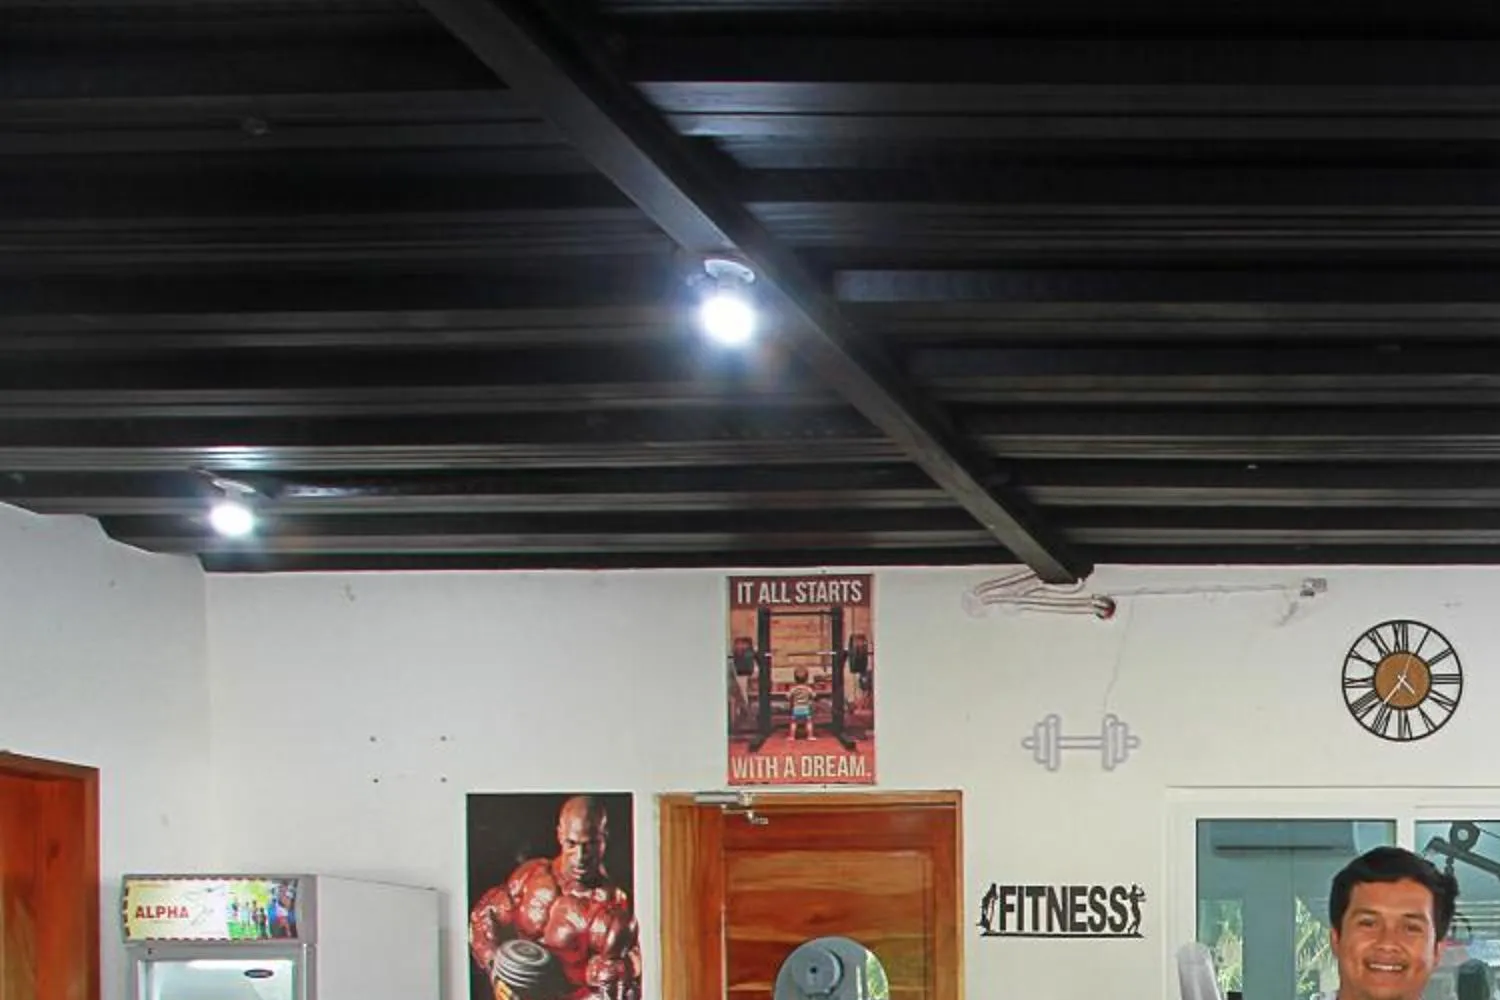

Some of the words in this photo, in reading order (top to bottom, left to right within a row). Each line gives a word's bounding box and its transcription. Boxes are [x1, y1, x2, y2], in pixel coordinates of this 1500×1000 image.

[738, 582, 754, 604] IT
[758, 582, 791, 603] ALL
[795, 580, 863, 603] STARTS
[732, 755, 780, 779] WITH
[783, 756, 797, 778] A
[801, 755, 872, 778] DREAM.
[135, 905, 189, 919] ALPHA
[999, 885, 1129, 932] FITNESS
